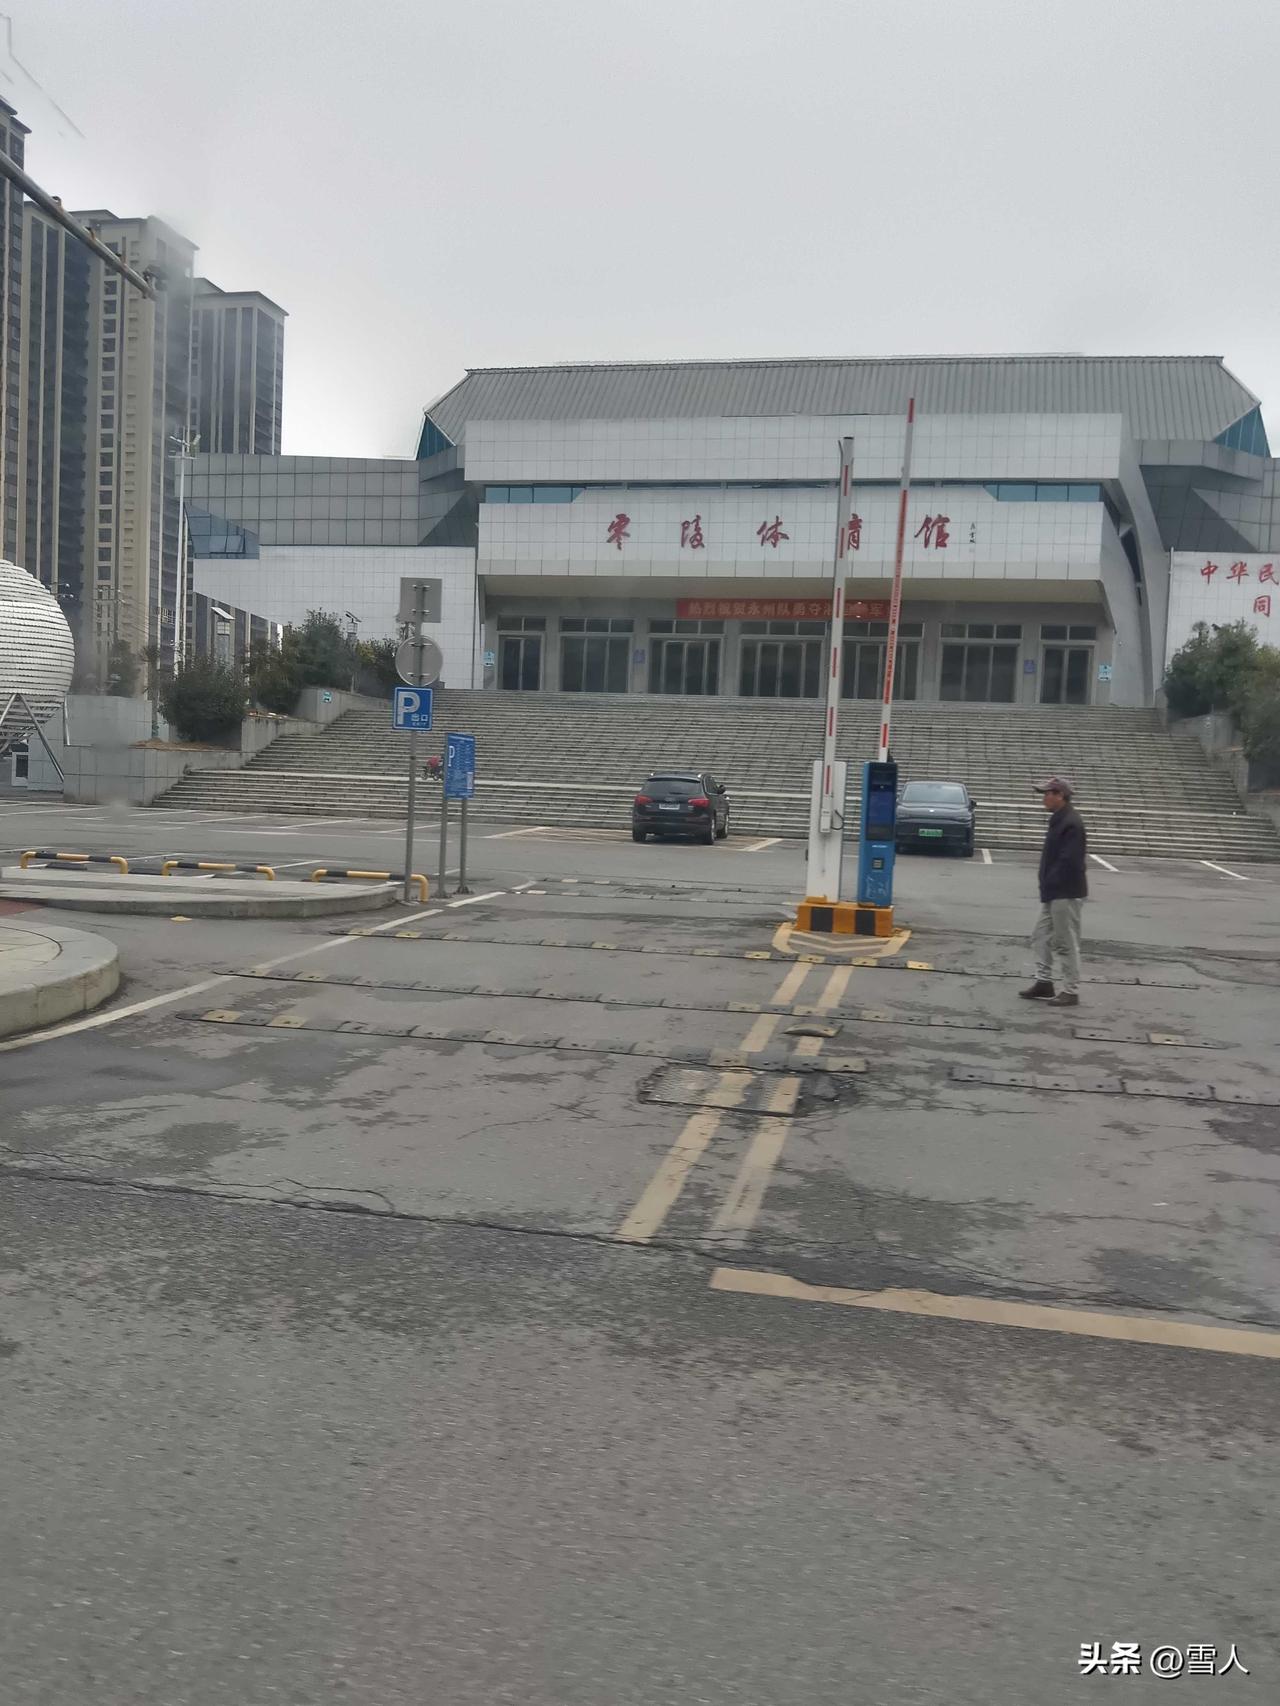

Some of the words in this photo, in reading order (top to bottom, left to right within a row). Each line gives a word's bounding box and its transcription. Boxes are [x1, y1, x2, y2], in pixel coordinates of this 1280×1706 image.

[606, 513, 950, 550] 零陵体育馆
[1200, 560, 1280, 586] 中华民
[1253, 594, 1272, 618] 同
[397, 691, 420, 725] P
[411, 713, 429, 722] 出口
[448, 745, 455, 767] P
